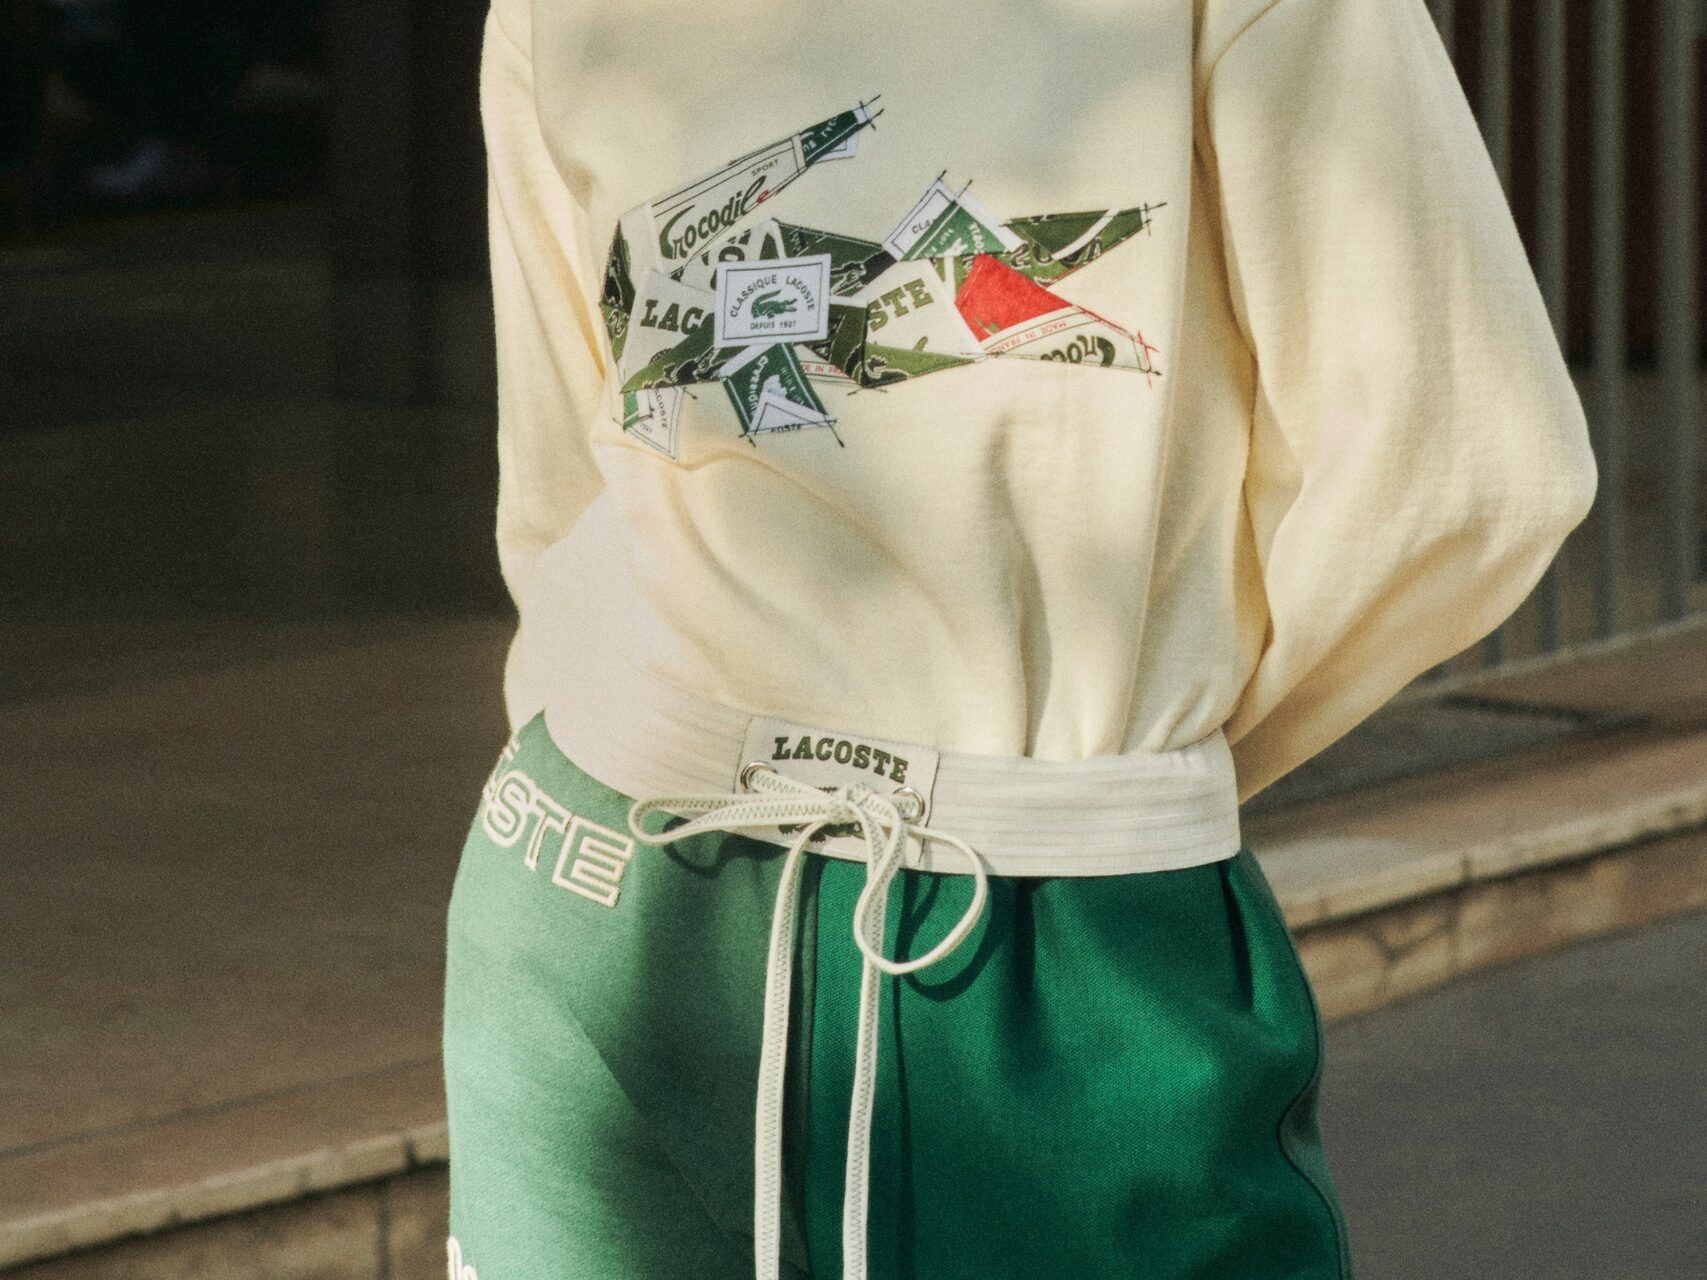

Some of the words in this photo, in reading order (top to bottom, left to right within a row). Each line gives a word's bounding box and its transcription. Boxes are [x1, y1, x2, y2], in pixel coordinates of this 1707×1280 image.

[751, 159, 779, 177] SPORT
[640, 299, 714, 336] LAC
[730, 274, 778, 318] CLASSIQUE
[786, 275, 816, 311] LACOSTE
[772, 736, 909, 784] LACOSTE
[482, 736, 635, 908] STE
